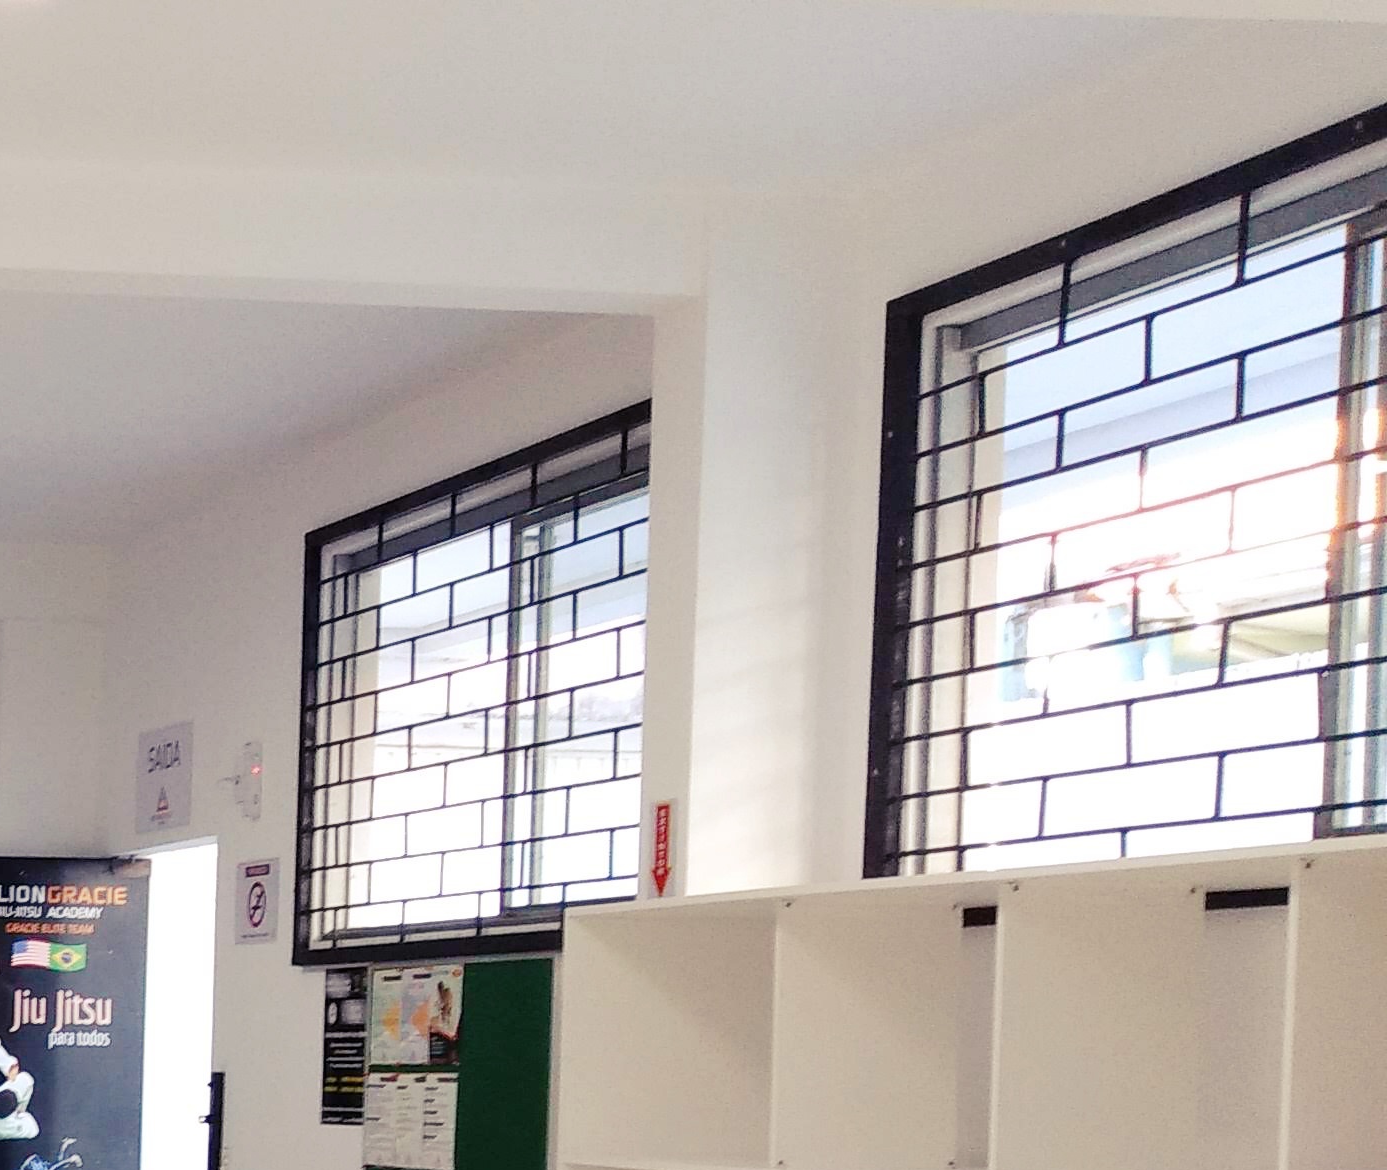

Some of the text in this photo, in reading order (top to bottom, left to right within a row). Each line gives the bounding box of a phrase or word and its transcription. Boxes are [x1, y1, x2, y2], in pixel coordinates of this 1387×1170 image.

[45, 906, 103, 920] ACADEMY
[9, 989, 112, 1033] Jiu Jitsu
[47, 1029, 111, 1049] para todos
